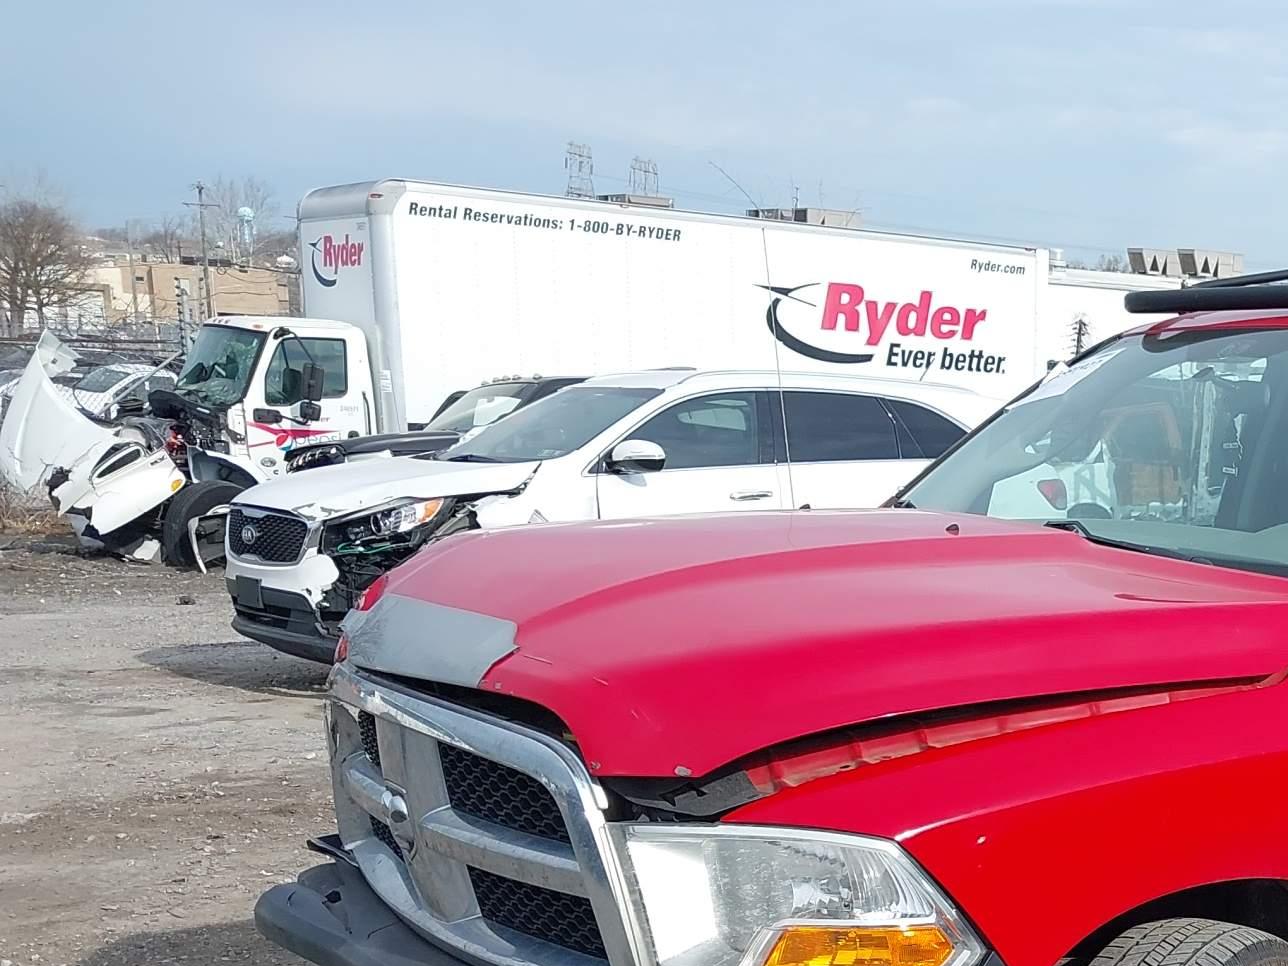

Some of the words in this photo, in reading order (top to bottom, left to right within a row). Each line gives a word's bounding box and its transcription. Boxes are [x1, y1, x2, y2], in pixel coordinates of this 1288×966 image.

[408, 202, 458, 219] Rental
[463, 207, 563, 229] Reservations:
[569, 218, 682, 242] 1-800-BY-RYDER
[323, 233, 364, 275] Ryder
[970, 259, 1025, 275] Ryder.com
[821, 282, 987, 346] Ryder
[886, 343, 936, 370] Ever
[940, 346, 1006, 374] better.
